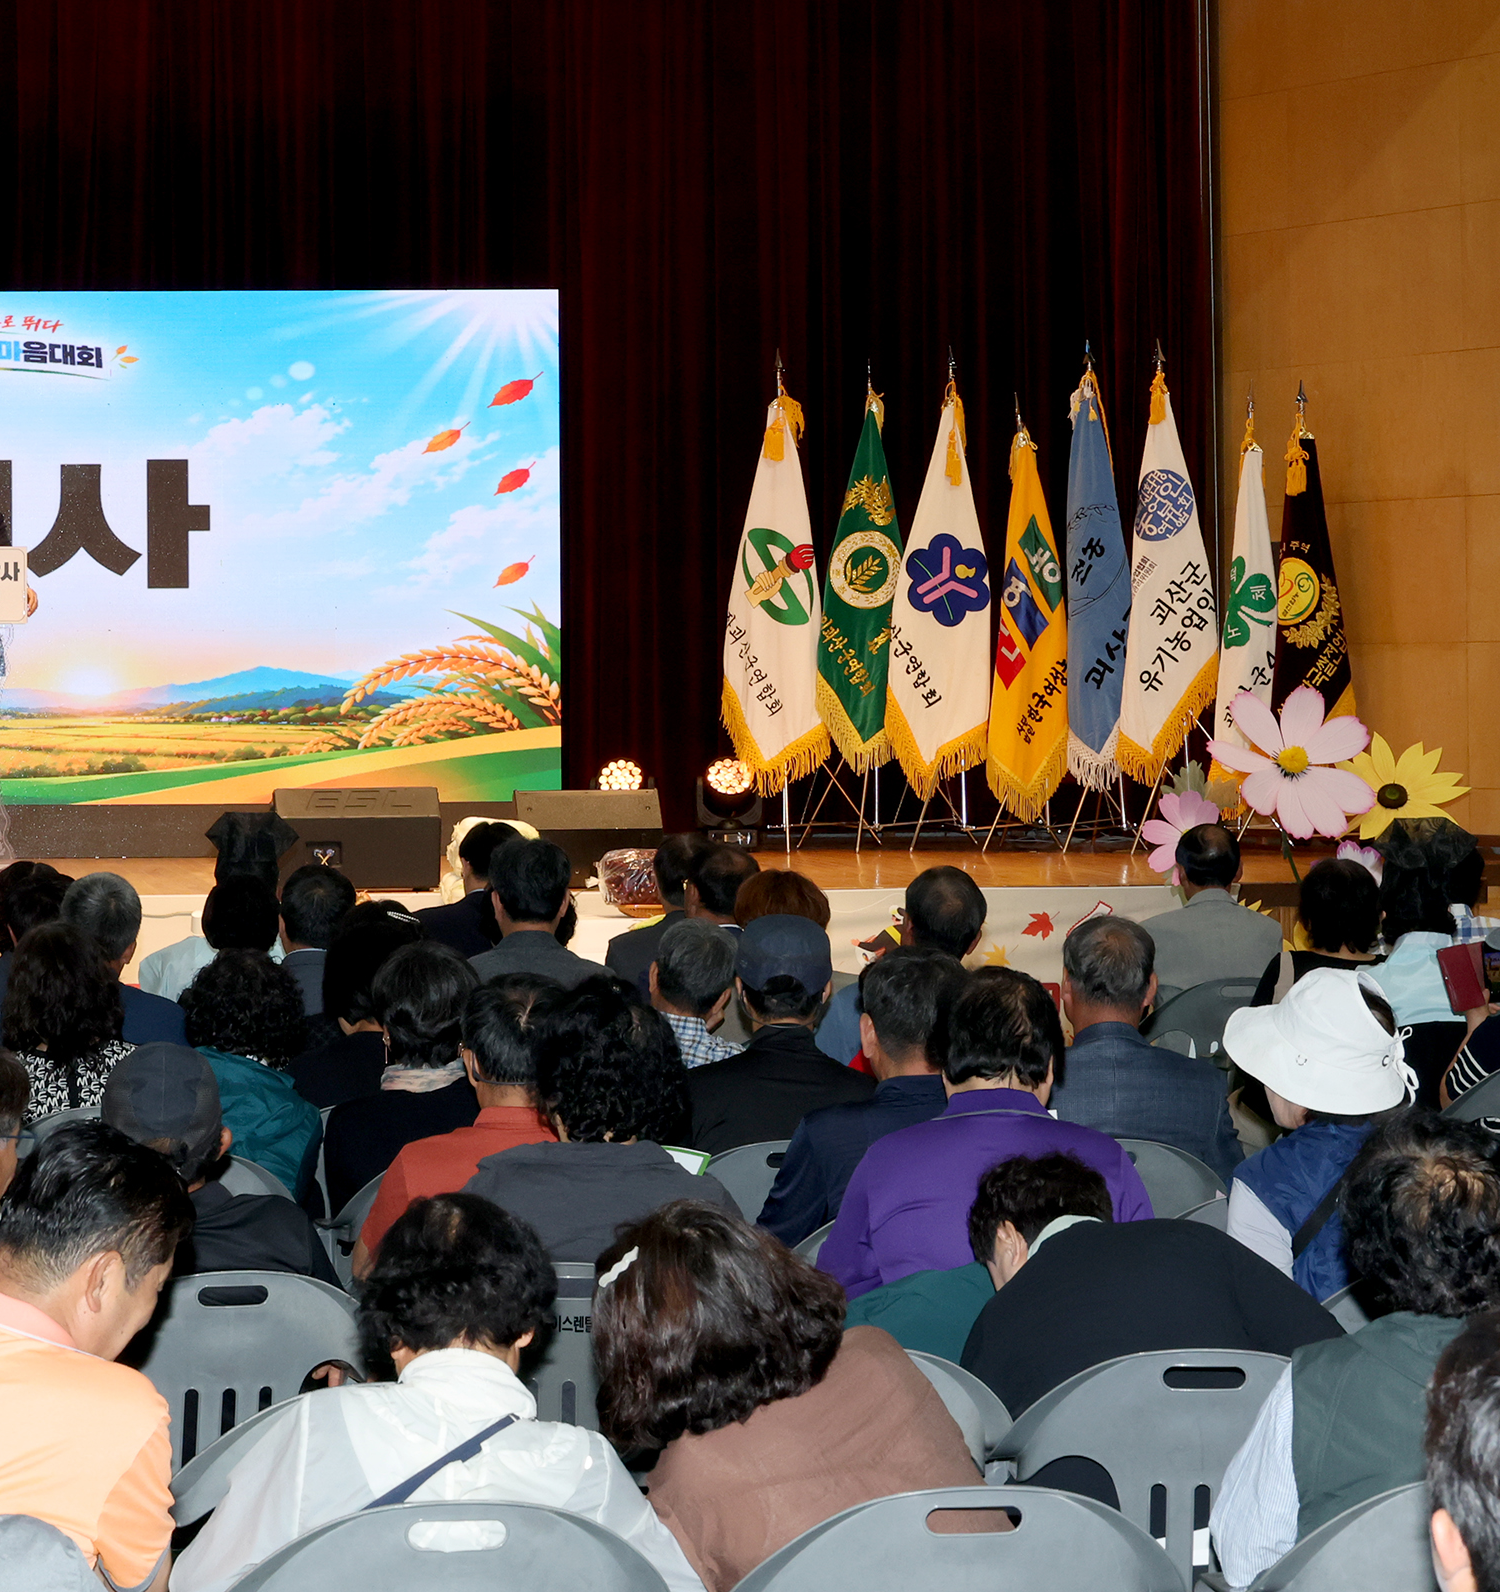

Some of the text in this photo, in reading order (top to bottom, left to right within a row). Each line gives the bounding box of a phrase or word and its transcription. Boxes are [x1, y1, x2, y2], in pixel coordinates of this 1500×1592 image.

[22, 315, 64, 334] 뛰다
[1071, 537, 1106, 586] 전농
[1150, 560, 1208, 627] 괴산군
[1139, 588, 1217, 692] 유기농업인
